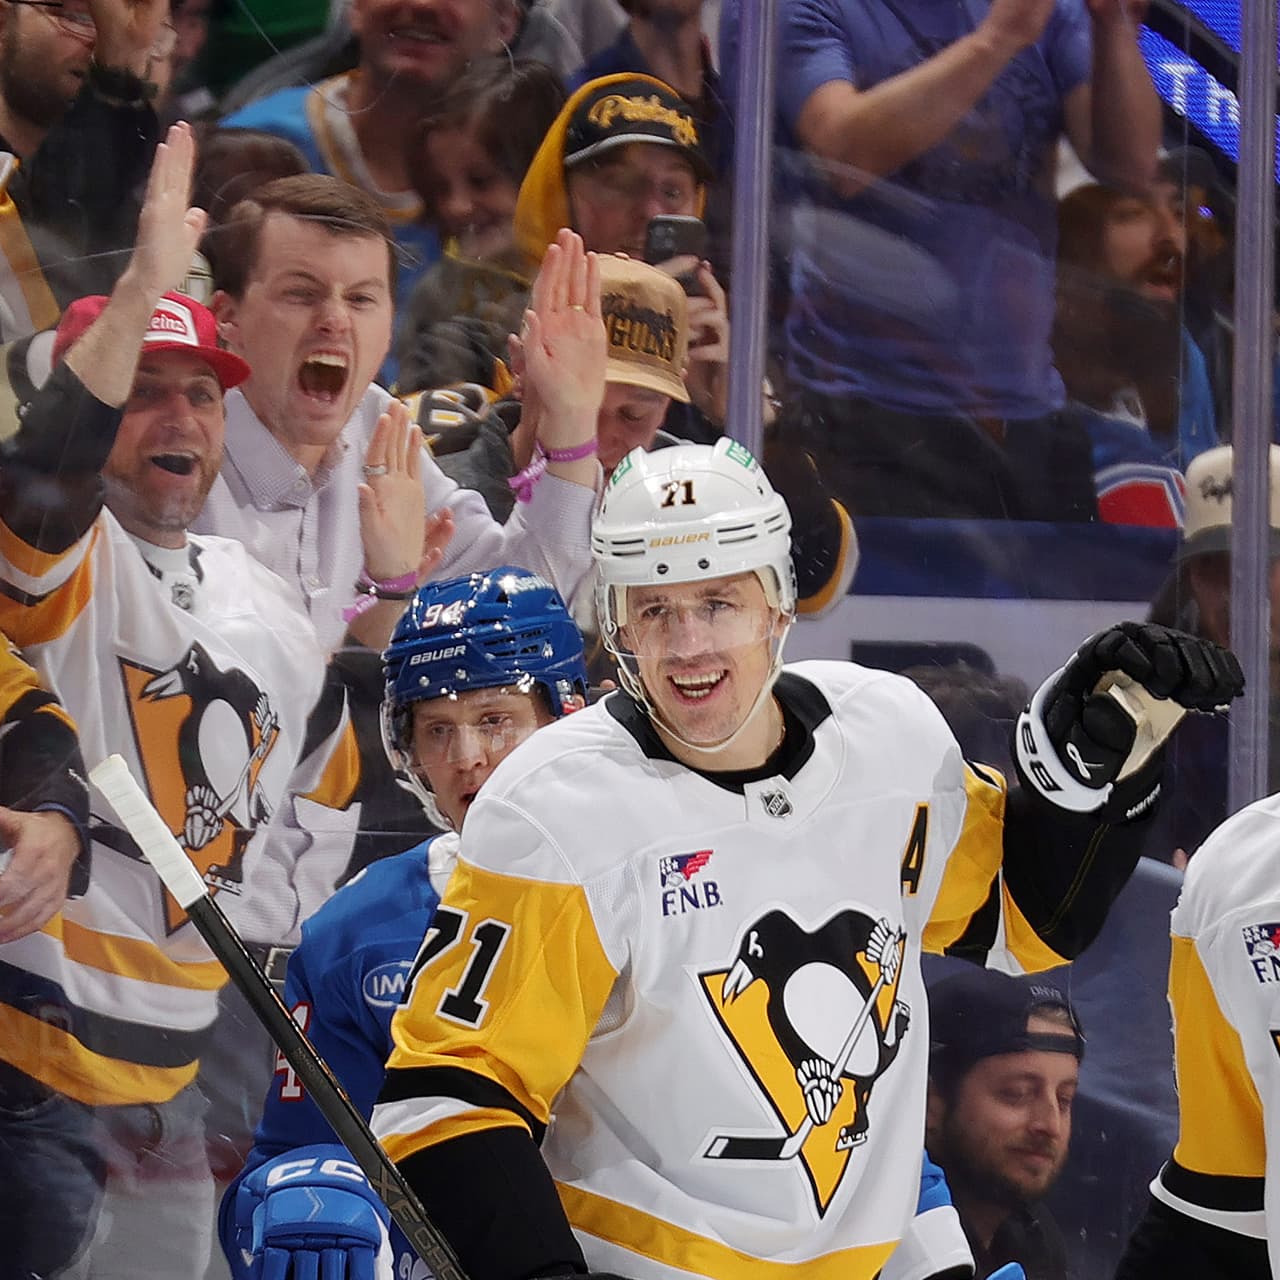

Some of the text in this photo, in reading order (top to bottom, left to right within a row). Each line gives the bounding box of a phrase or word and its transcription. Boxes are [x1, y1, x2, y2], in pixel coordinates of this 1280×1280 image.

[661, 480, 696, 508] 71
[419, 602, 464, 630] 94
[899, 801, 929, 898] A
[397, 904, 512, 1030] 71
[266, 1156, 367, 1187] CC
